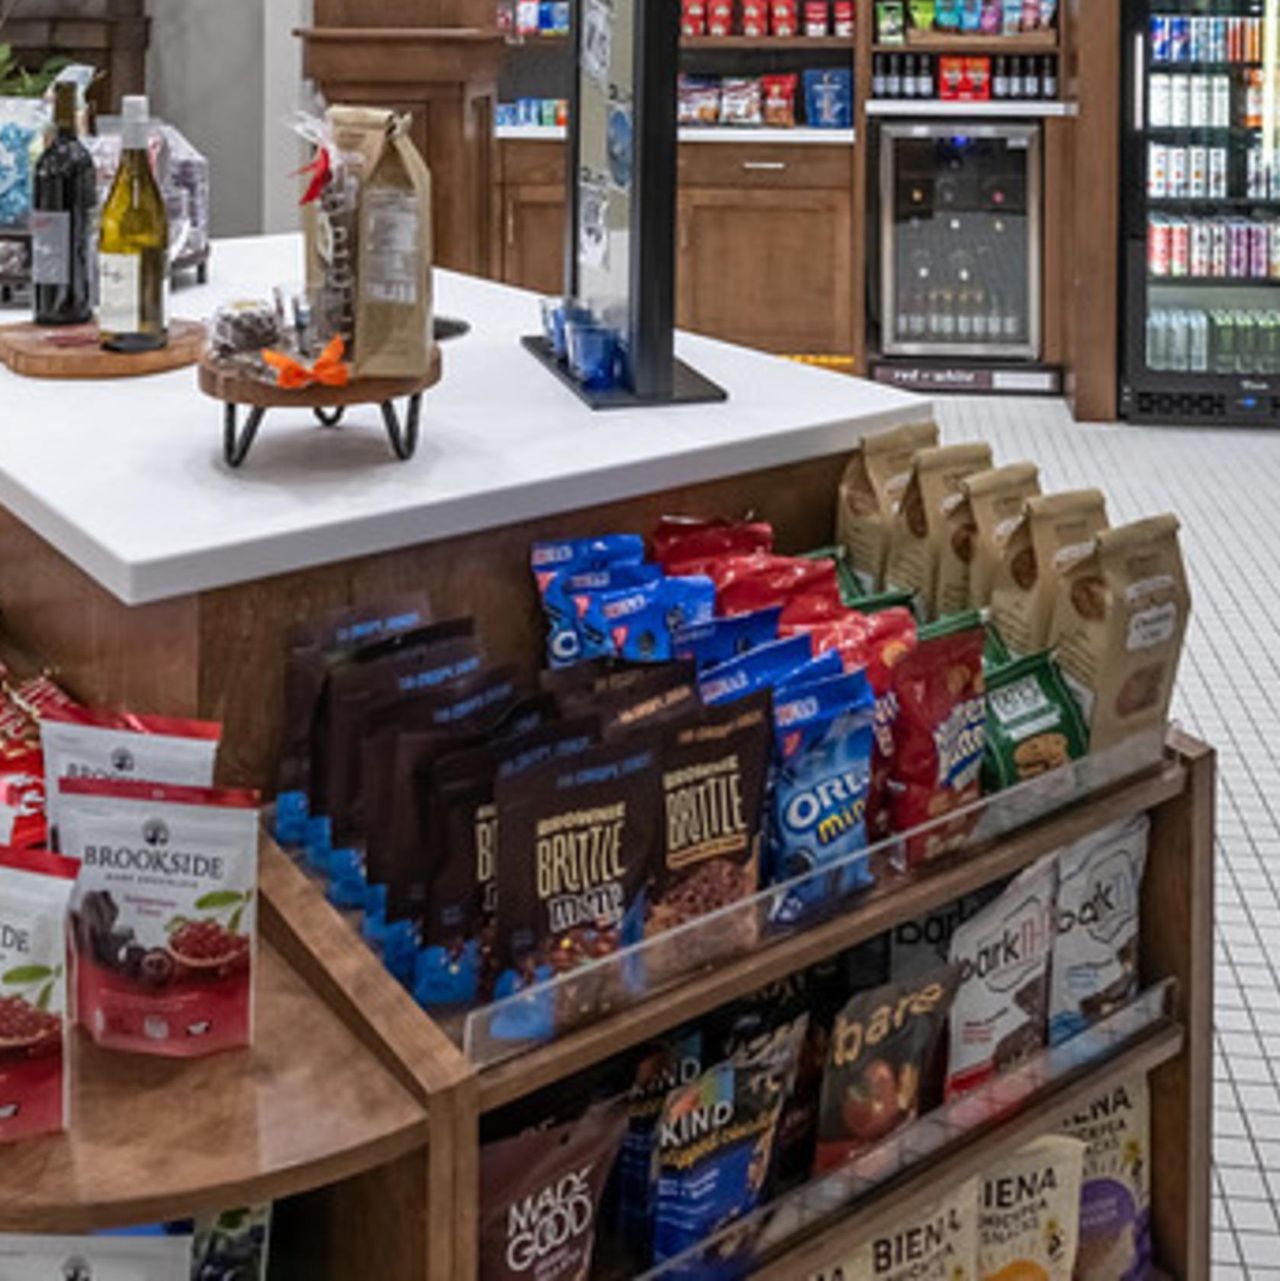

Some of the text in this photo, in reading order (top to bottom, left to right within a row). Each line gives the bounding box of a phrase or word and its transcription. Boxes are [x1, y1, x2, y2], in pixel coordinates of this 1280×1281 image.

[785, 771, 870, 829] ORE
[84, 845, 225, 880] BROOKSIDE
[537, 819, 627, 900] BRITTLE
[834, 982, 942, 1066] bare
[660, 1101, 734, 1147] KIND
[980, 1167, 1057, 1209] IENA
[506, 1193, 593, 1272] GOOD
